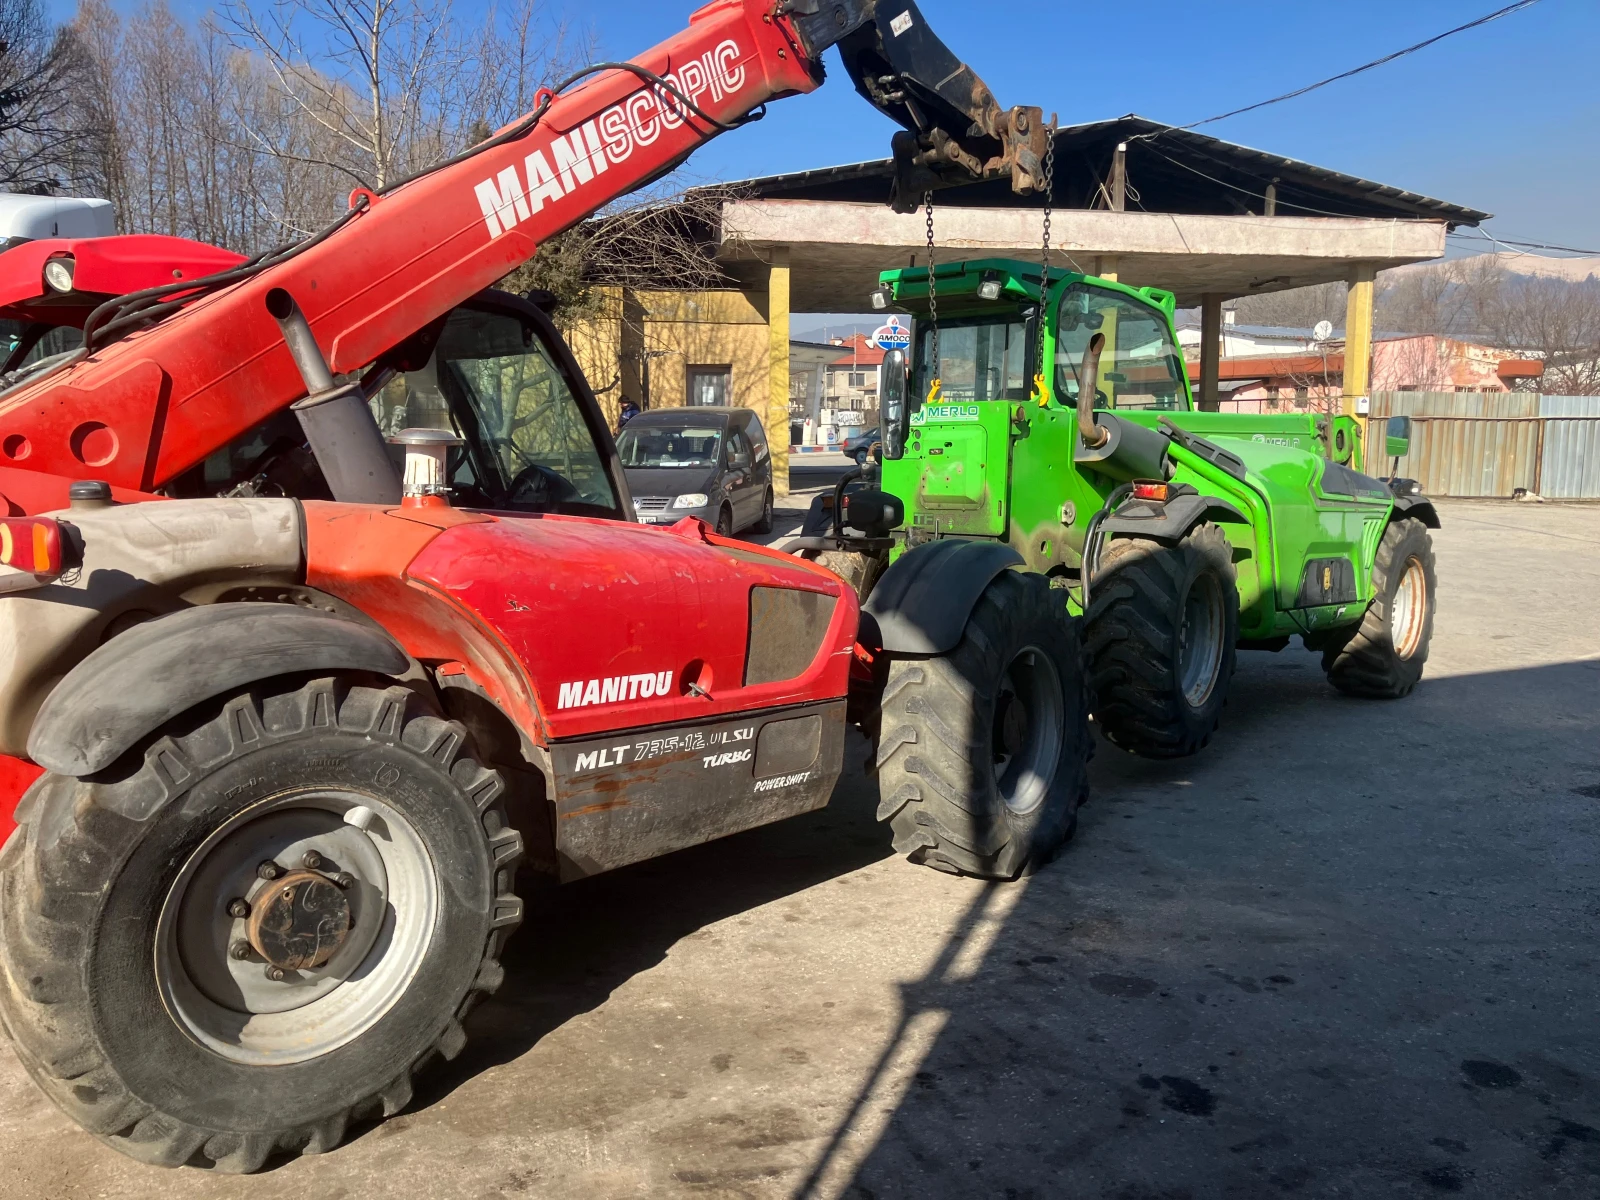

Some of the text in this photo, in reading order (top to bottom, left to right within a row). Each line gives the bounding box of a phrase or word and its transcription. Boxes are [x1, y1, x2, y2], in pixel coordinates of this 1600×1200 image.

[474, 39, 747, 239] MANISCOPIC
[878, 334, 910, 342] AMOCO
[928, 406, 979, 417] MERLO
[557, 670, 673, 710] MANITOU
[574, 745, 630, 772] MLT
[753, 772, 811, 792] POWERSHIFT
